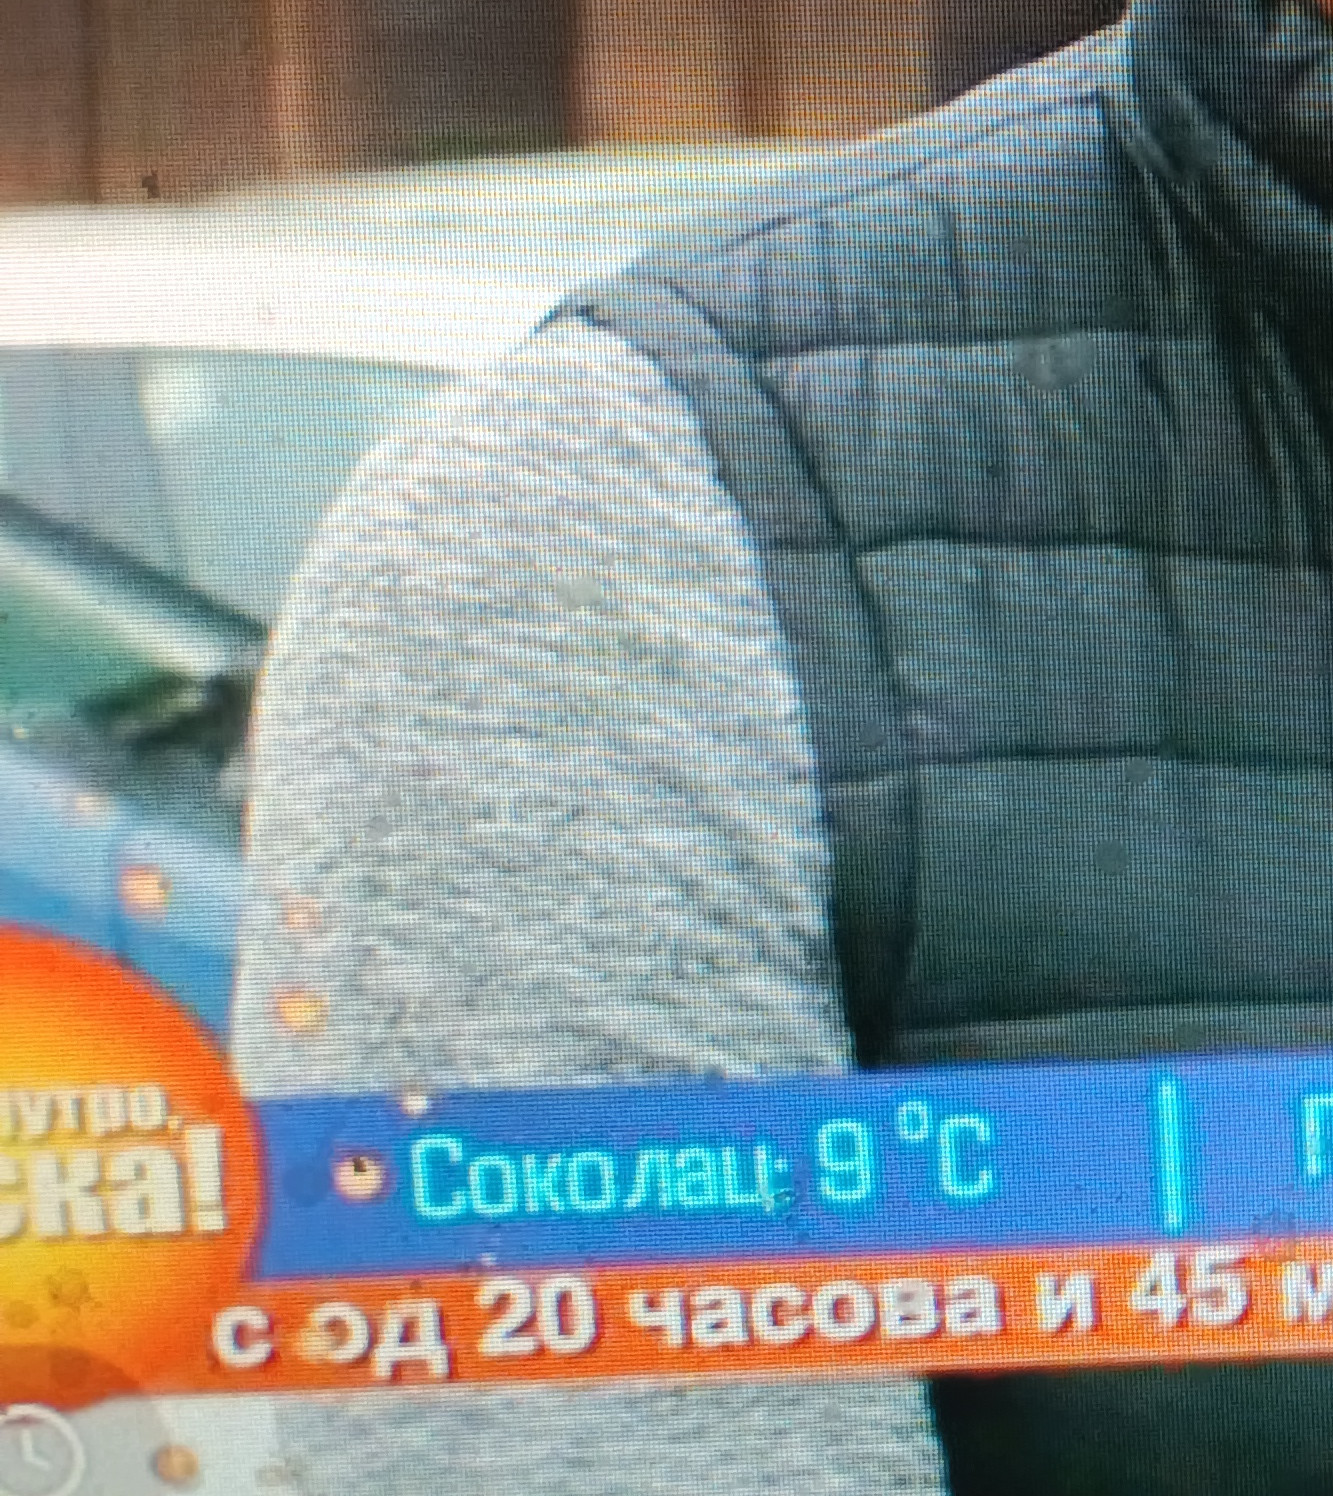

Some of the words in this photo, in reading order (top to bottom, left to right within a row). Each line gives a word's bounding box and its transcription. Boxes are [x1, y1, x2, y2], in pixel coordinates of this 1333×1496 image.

[410, 1133, 795, 1220] Соколац:
[815, 1116, 875, 1202] 9
[212, 1303, 275, 1368] с
[298, 1297, 452, 1379] од
[474, 1275, 597, 1359] 20
[627, 1273, 1000, 1349] часова
[1037, 1266, 1098, 1334] и
[1127, 1248, 1251, 1330] 45
